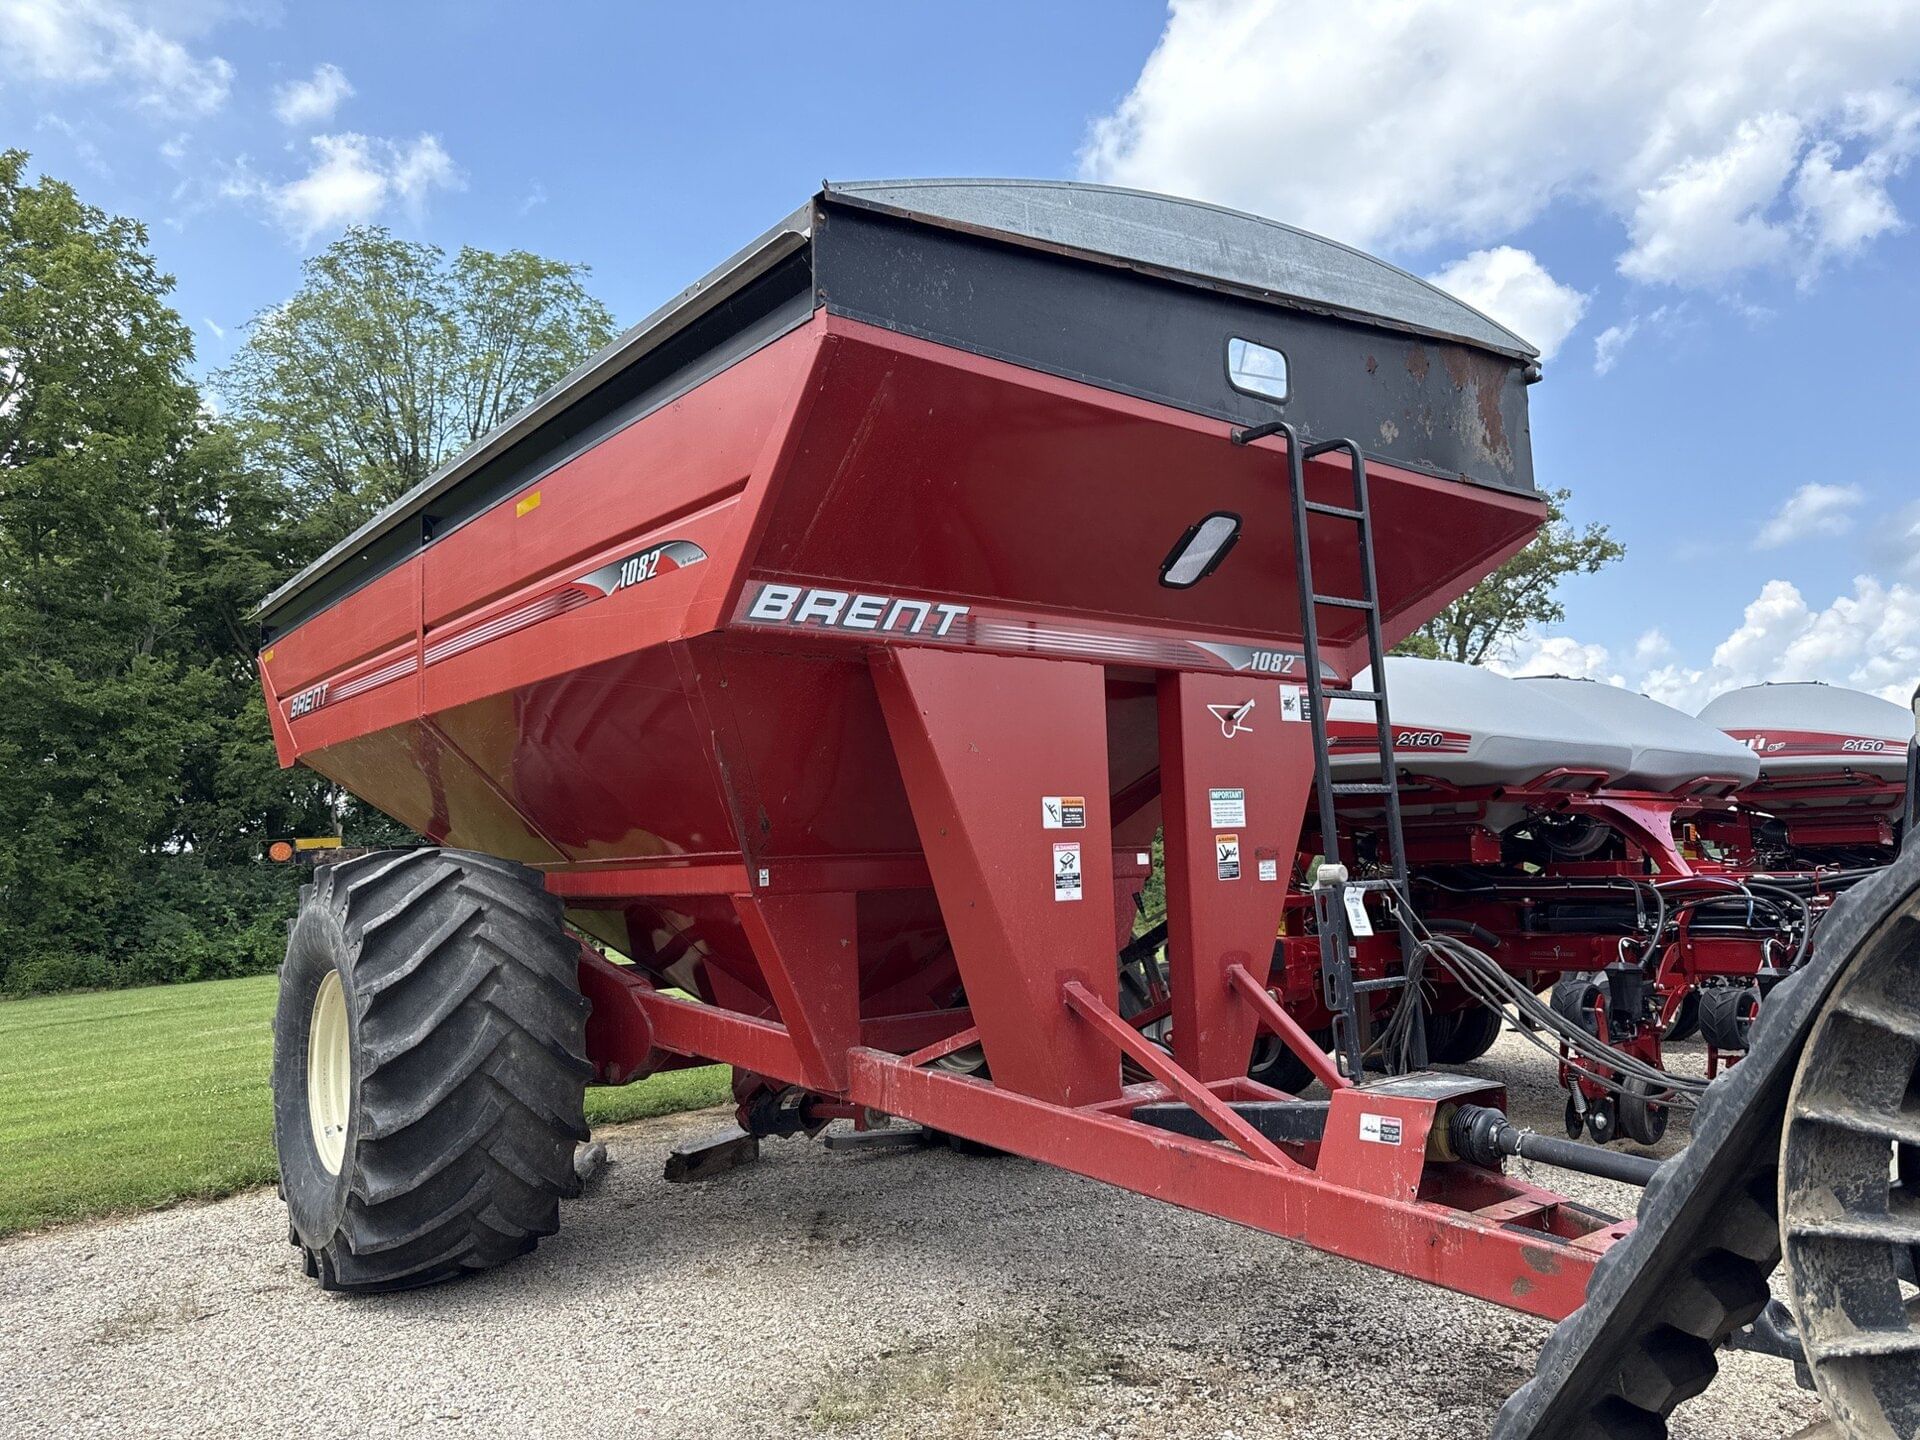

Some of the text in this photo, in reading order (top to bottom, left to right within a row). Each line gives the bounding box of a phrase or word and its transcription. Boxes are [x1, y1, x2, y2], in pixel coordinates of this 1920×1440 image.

[618, 548, 661, 589] 1082
[748, 583, 970, 637] BRENT
[1250, 650, 1295, 674] 1082
[289, 683, 330, 718] BRENT
[1396, 732, 1443, 747] 2150
[1842, 739, 1885, 752] 2150
[1211, 791, 1242, 800] IMPORTANT
